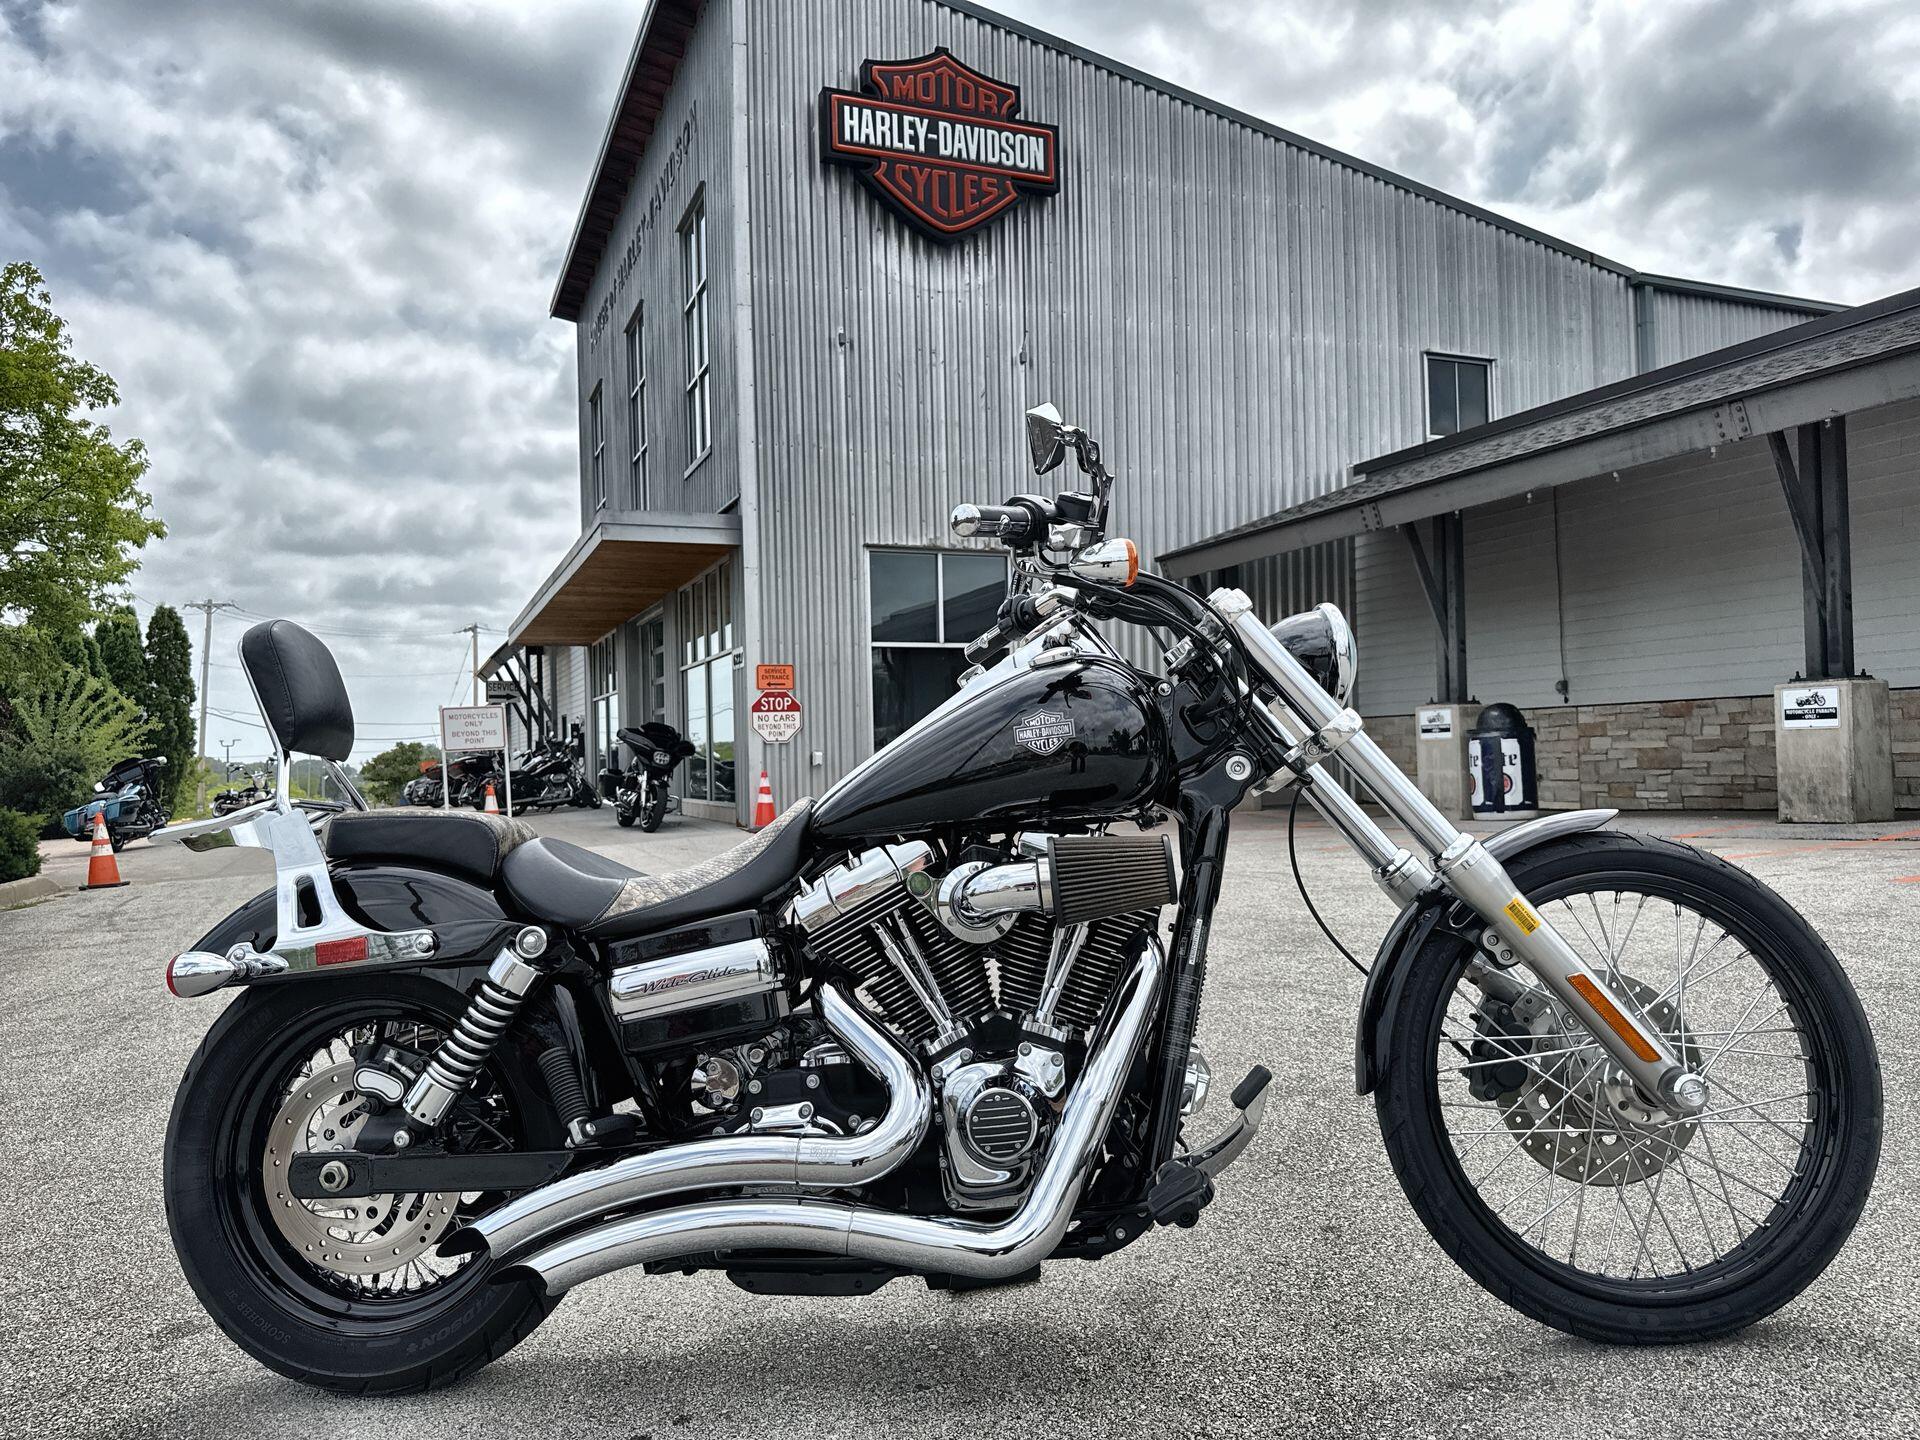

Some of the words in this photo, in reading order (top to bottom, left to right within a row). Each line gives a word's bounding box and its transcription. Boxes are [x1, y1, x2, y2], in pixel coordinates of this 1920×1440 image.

[893, 66, 998, 116] MOTOR
[843, 105, 1045, 172] HARLEY-DAVIDSON
[895, 164, 998, 218] CYCLES
[761, 697, 792, 711] STOP
[448, 712, 498, 720] MOTORCYCLES
[757, 714, 770, 723] NO
[773, 714, 796, 722] CARS
[1029, 715, 1057, 726] MOTOR
[1018, 725, 1070, 739] HARLEY-DAVIDSON
[1031, 738, 1059, 751] CYCLES
